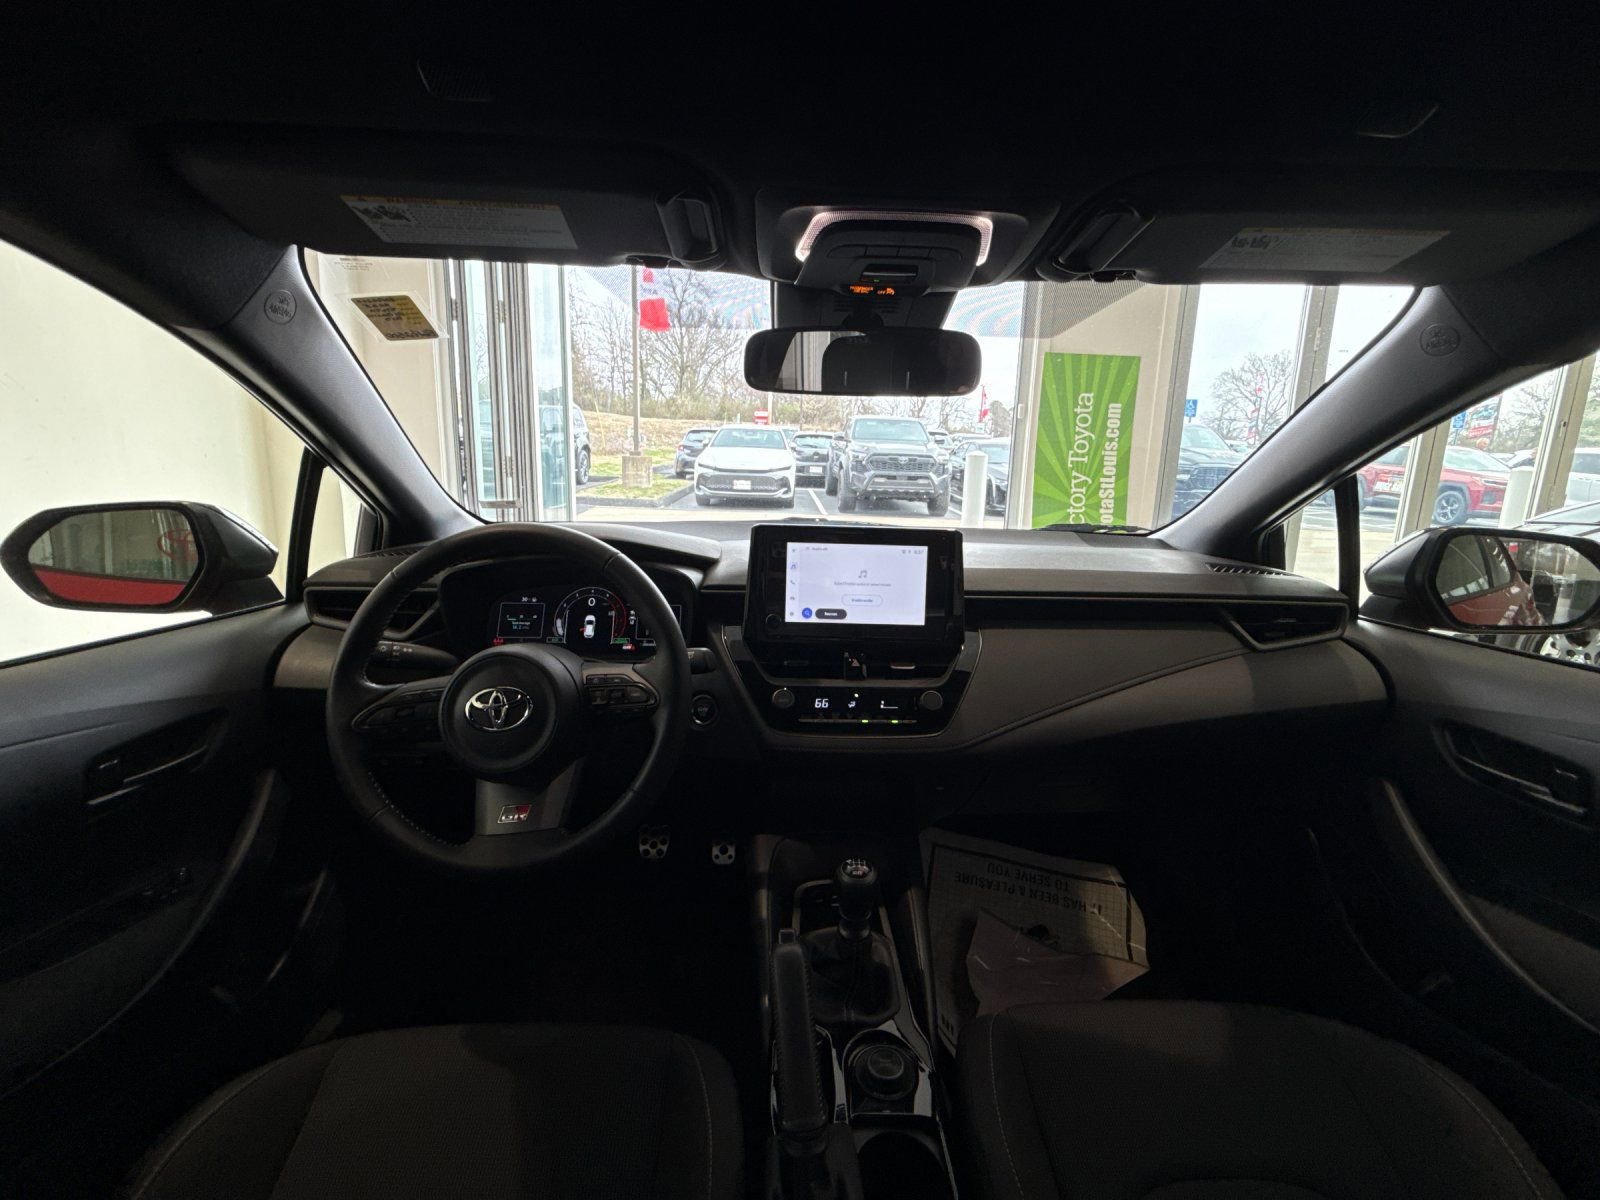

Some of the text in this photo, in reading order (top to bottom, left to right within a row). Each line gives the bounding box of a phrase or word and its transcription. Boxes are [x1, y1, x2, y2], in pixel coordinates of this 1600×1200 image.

[1068, 392, 1095, 524] ctory Toyota
[588, 597, 596, 607] 0
[815, 698, 829, 708] 66
[954, 871, 1016, 894] PLEASURE
[986, 862, 1070, 891] TO SERVE YOU
[1029, 888, 1060, 905] BEEN
[1062, 896, 1087, 912] HAS
